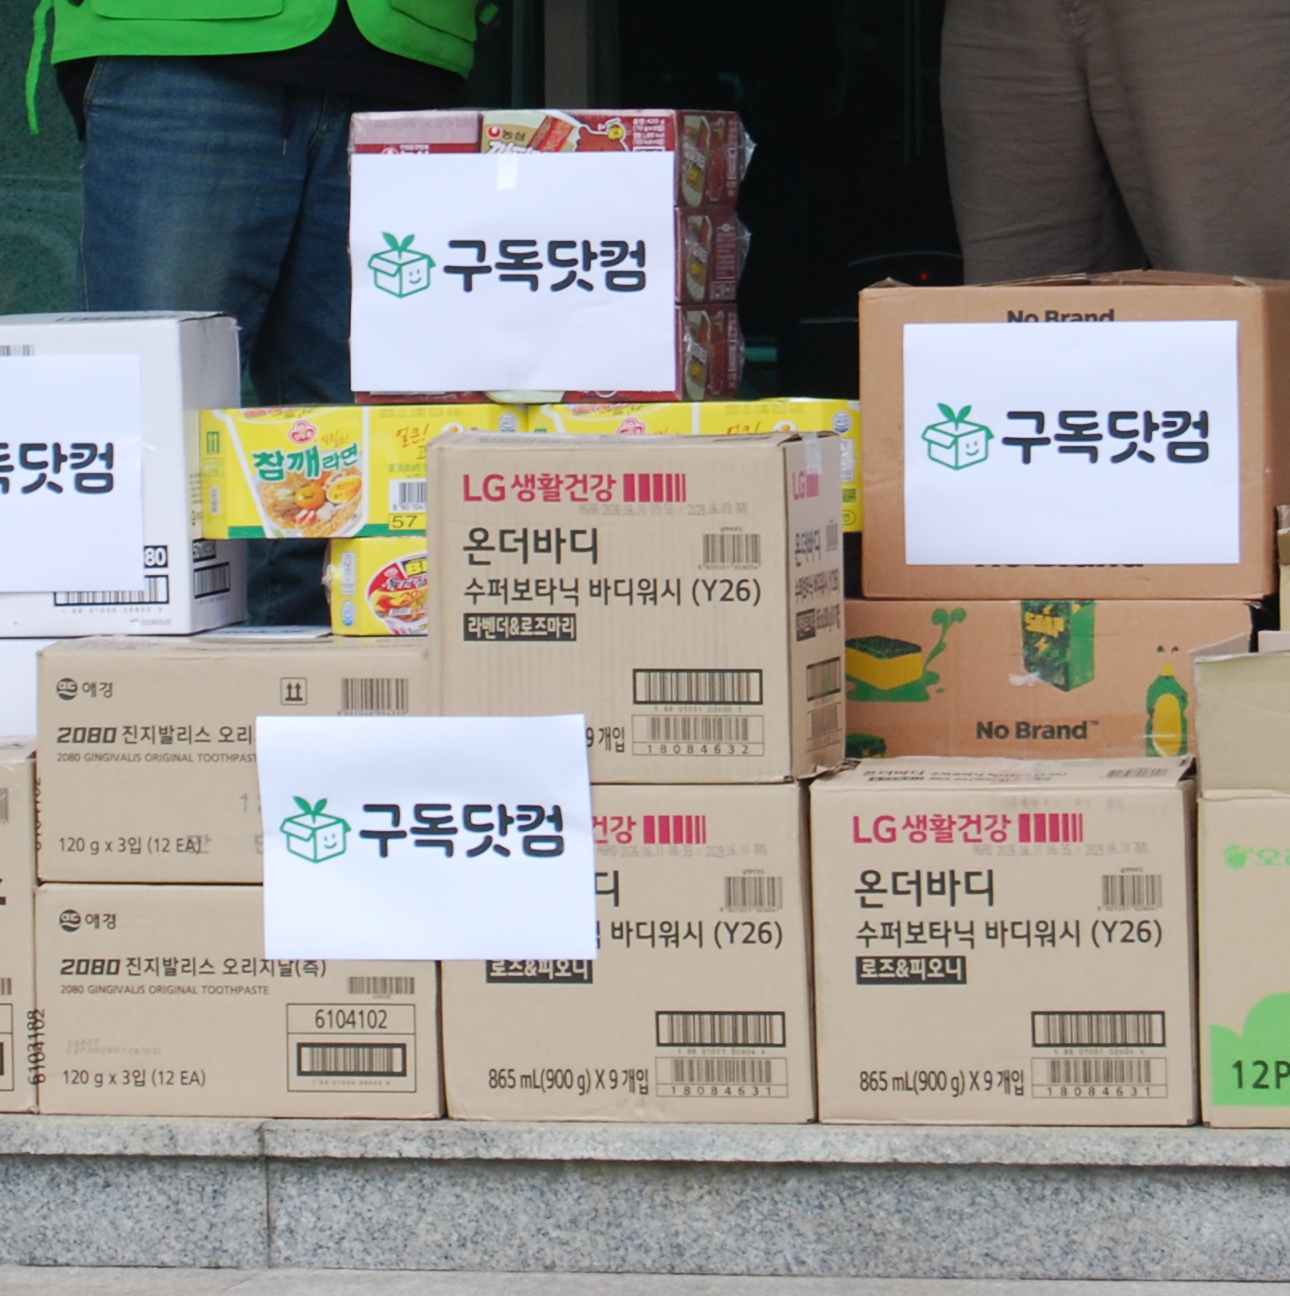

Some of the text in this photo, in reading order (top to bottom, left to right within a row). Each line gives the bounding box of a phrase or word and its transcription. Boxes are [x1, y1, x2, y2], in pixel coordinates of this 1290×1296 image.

[443, 239, 646, 292] 구독닷컴
[1002, 409, 1209, 464] 구독닷컴
[462, 527, 599, 566] 온더바디
[464, 578, 761, 606] 수퍼보타닉 바디워시 (Y26)
[467, 616, 575, 638] 라벤더&로즈마리
[81, 681, 114, 699] 애경
[56, 727, 117, 744] 2080
[122, 725, 212, 745] 진지발리스
[598, 725, 626, 753] 개입
[976, 720, 1088, 740] No Brand
[56, 754, 257, 764] 2080 GINGIVALIS ORIGINAL TOOTHPAST
[359, 804, 565, 859] 구독닷컴
[59, 838, 86, 853] 120
[90, 840, 100, 856] g
[118, 837, 142, 854] 3입
[147, 837, 171, 855] (12
[854, 869, 995, 909] 온더바디
[85, 914, 117, 930] 애경
[611, 920, 783, 949] 바디워시 (Y26)
[856, 920, 1162, 949] 수퍼보타닉 바디워시 (Y26)
[60, 959, 121, 976] 2080
[125, 957, 215, 977] 진지발리스
[490, 960, 588, 980] 로즈&피오니
[860, 958, 962, 980] 로즈&피오니
[60, 985, 269, 996] 2080 GINGIVALIS ORIGINAL TOOTHPASTE
[315, 1010, 388, 1029] 6104102
[63, 1070, 89, 1085] 120
[94, 1072, 104, 1088] g
[122, 1069, 146, 1087] 3입
[151, 1069, 174, 1087] (12
[180, 1069, 206, 1088] EA)
[488, 1069, 516, 1090] 865
[622, 1068, 649, 1095] 개입
[860, 1071, 887, 1092] 865
[997, 1070, 1025, 1097] 개입
[671, 1085, 772, 1096] 18084631
[1047, 1086, 1151, 1097] 18084631
